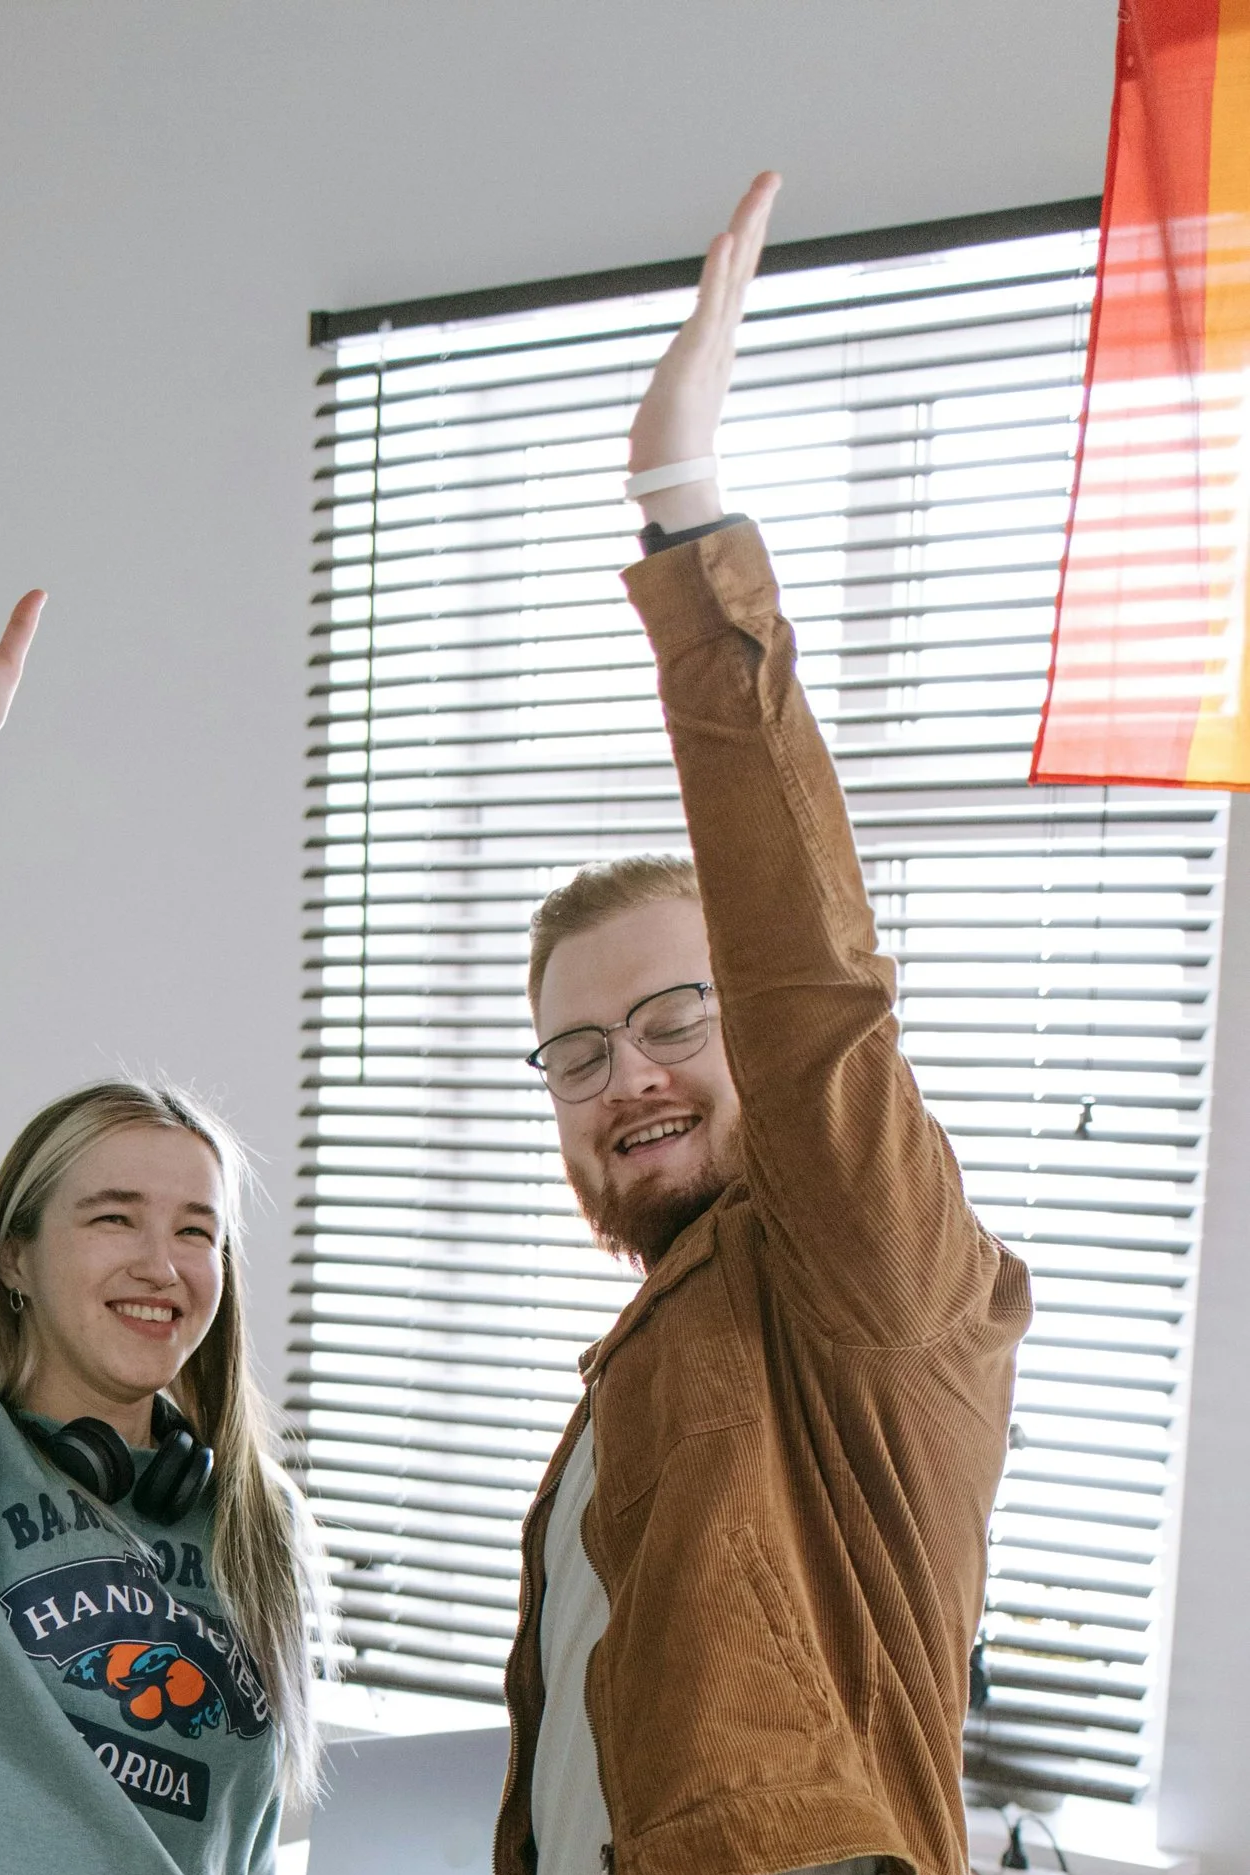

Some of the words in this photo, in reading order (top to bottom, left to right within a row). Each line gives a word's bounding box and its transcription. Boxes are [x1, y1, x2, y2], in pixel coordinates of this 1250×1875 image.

[23, 1585, 154, 1641] HAND
[165, 1592, 268, 1722] PICKED
[94, 1742, 192, 1806] ORIDA
